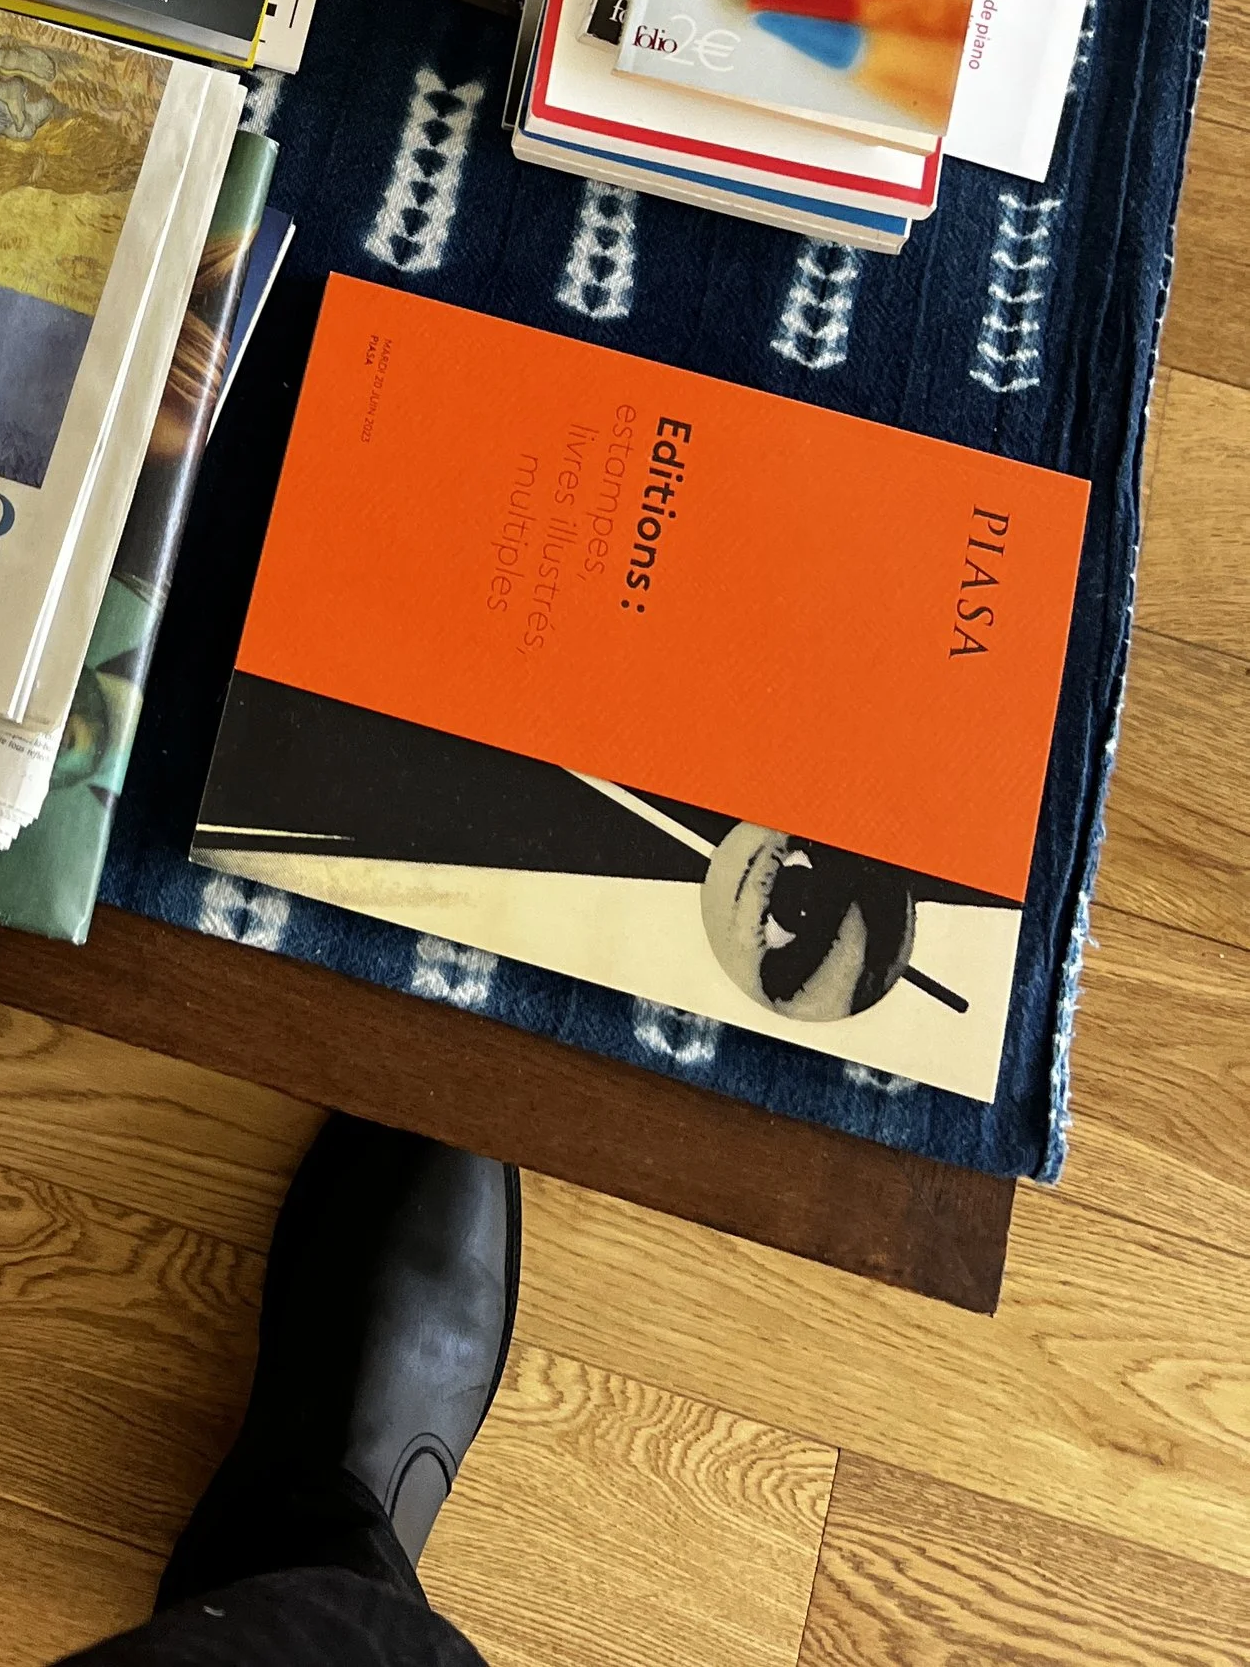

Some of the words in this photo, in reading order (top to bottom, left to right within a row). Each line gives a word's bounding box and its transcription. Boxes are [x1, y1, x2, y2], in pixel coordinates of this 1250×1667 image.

[981, 0, 998, 22] de
[632, 24, 678, 54] folio
[968, 23, 991, 71] piano
[364, 334, 379, 366] PIASA
[555, 424, 599, 506] livres
[487, 453, 538, 612] multiples
[949, 504, 1010, 659] PIASA
